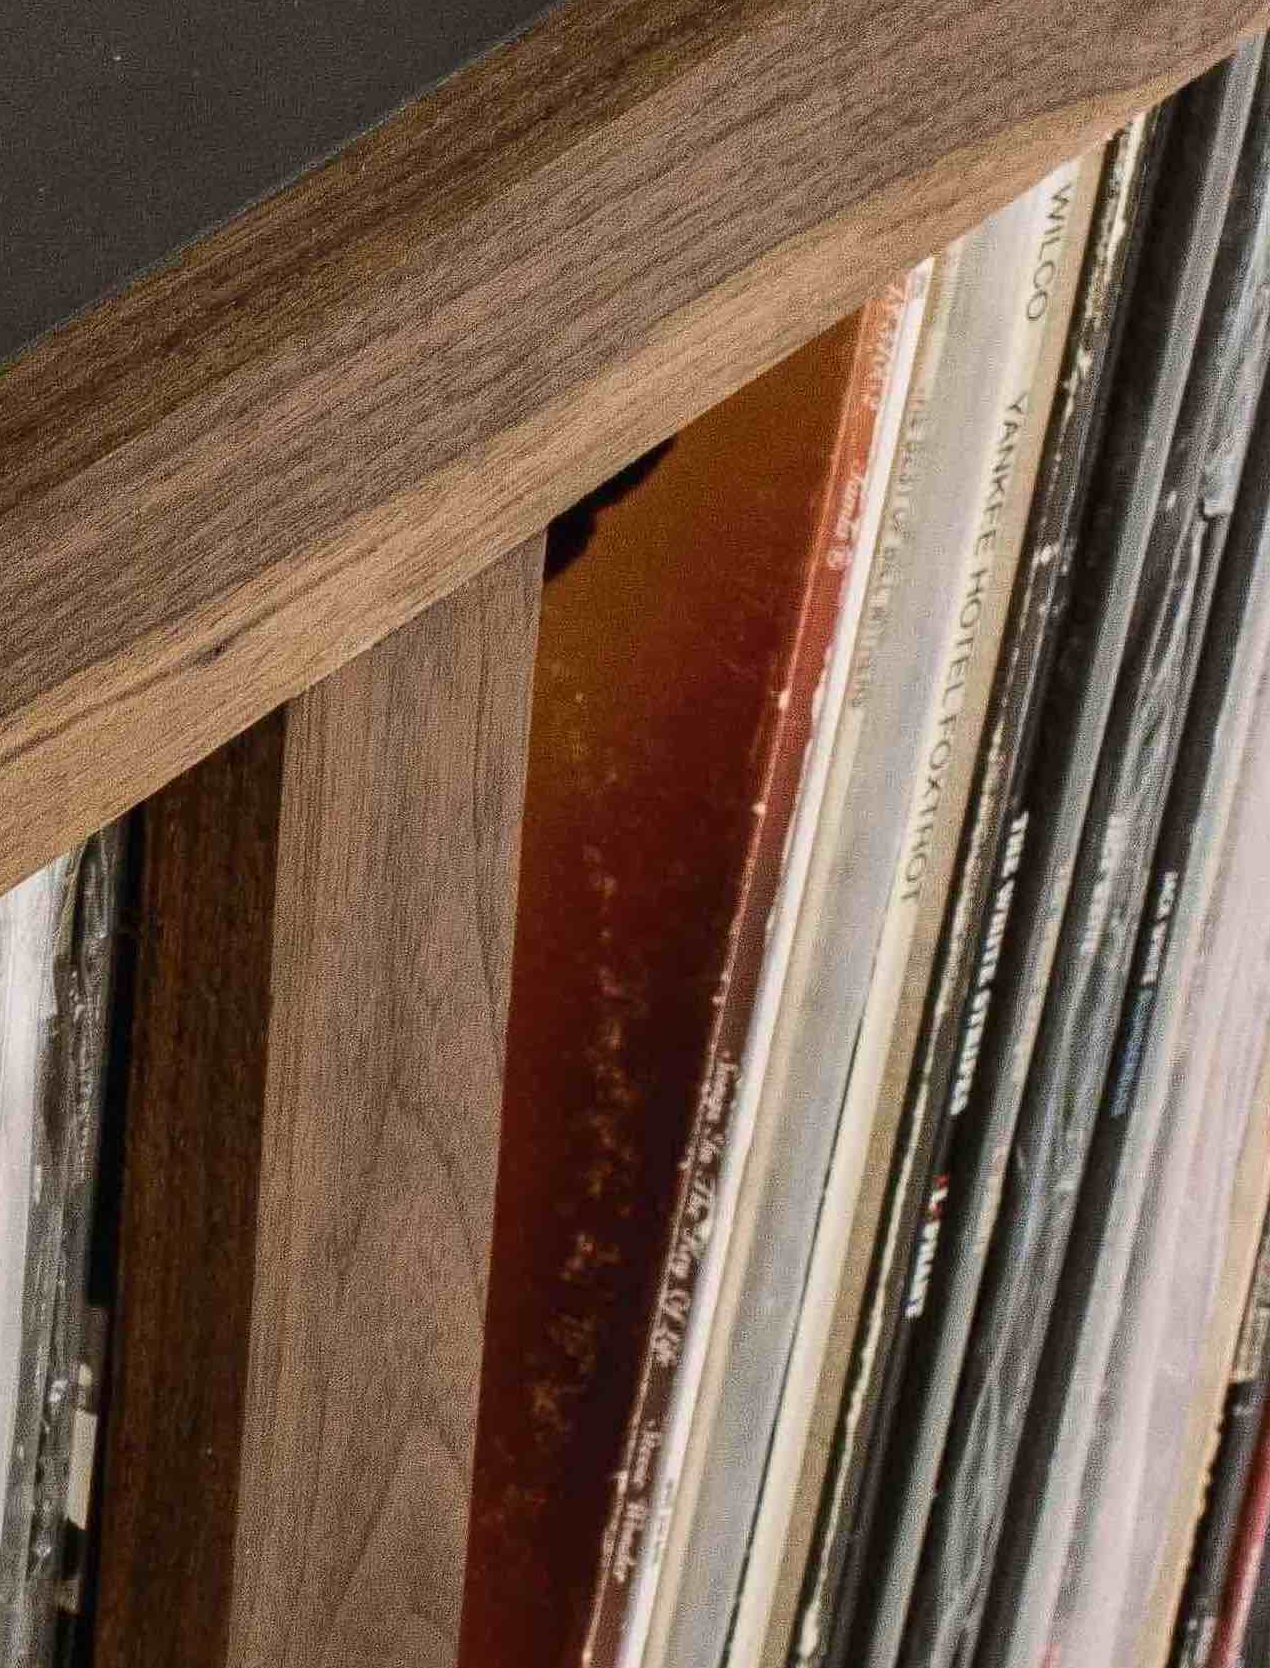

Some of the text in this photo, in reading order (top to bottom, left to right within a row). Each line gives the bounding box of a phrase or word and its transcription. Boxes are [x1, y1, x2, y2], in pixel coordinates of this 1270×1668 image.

[899, 182, 1073, 904] WILCO YANKEE HOTEL FOXTROT
